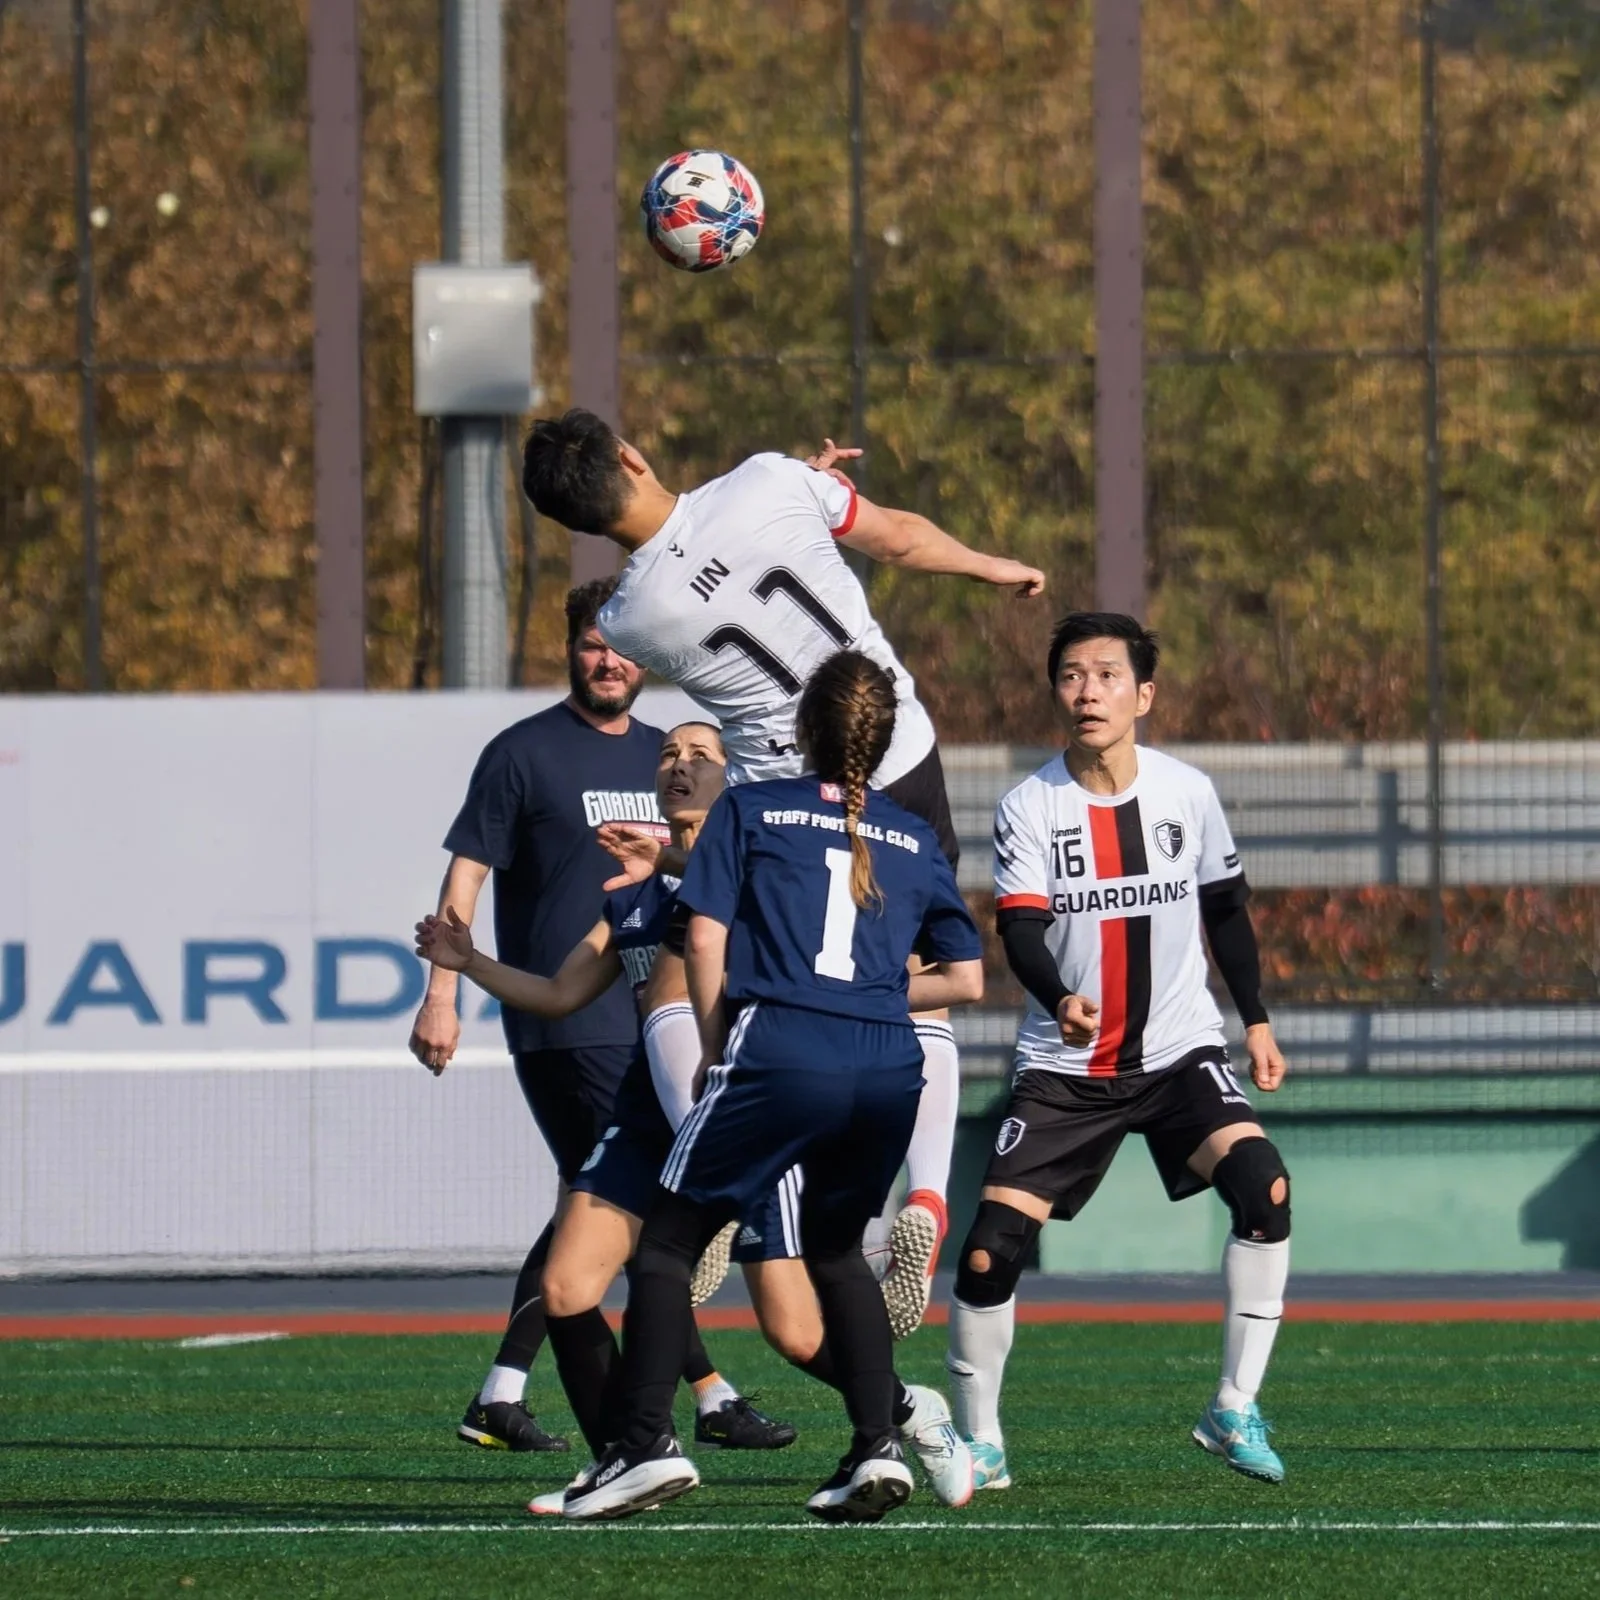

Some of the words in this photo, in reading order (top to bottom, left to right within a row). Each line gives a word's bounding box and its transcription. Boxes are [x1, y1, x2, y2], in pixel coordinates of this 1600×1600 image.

[689, 557, 730, 602] JIN
[762, 811, 810, 825] STAFF
[811, 813, 884, 841] FOOTALL
[886, 829, 920, 854] CLUB
[1051, 838, 1085, 880] 16
[814, 847, 857, 982] 1
[1052, 880, 1188, 914] GUARDIANS
[596, 1457, 627, 1488] HOKA
